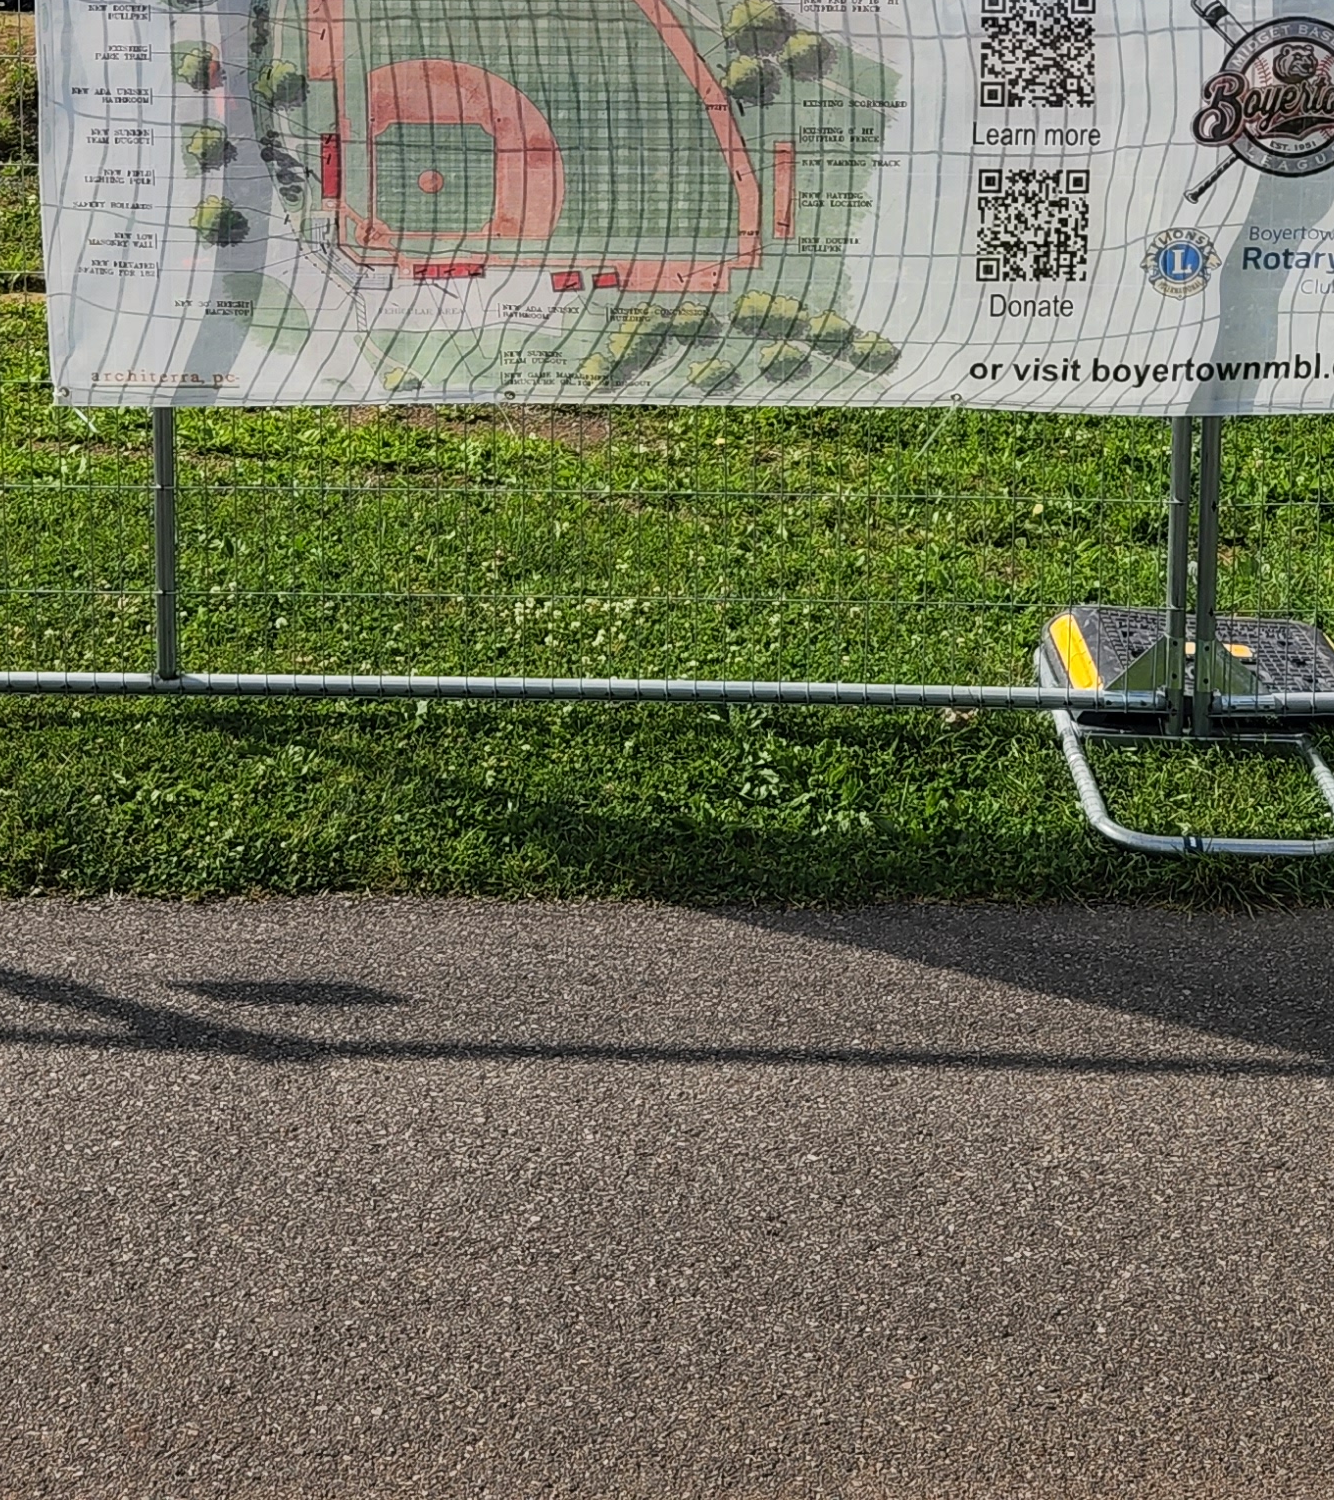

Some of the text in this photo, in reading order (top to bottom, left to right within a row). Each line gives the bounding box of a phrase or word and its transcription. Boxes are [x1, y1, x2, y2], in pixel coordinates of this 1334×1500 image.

[1231, 23, 1291, 69] MIDGET
[848, 100, 908, 108] SCOREBOARD
[850, 135, 880, 143] FENCE
[972, 123, 1102, 146] Learn more
[1270, 141, 1317, 152] EST. 1951
[830, 200, 873, 208] LOCATION
[1157, 229, 1206, 246] LIONS
[1172, 249, 1193, 274] L
[439, 307, 465, 315] AREA
[989, 293, 1074, 318] Donate
[91, 369, 205, 384] architerra,
[969, 363, 1003, 381] or
[1013, 357, 1081, 382] visit
